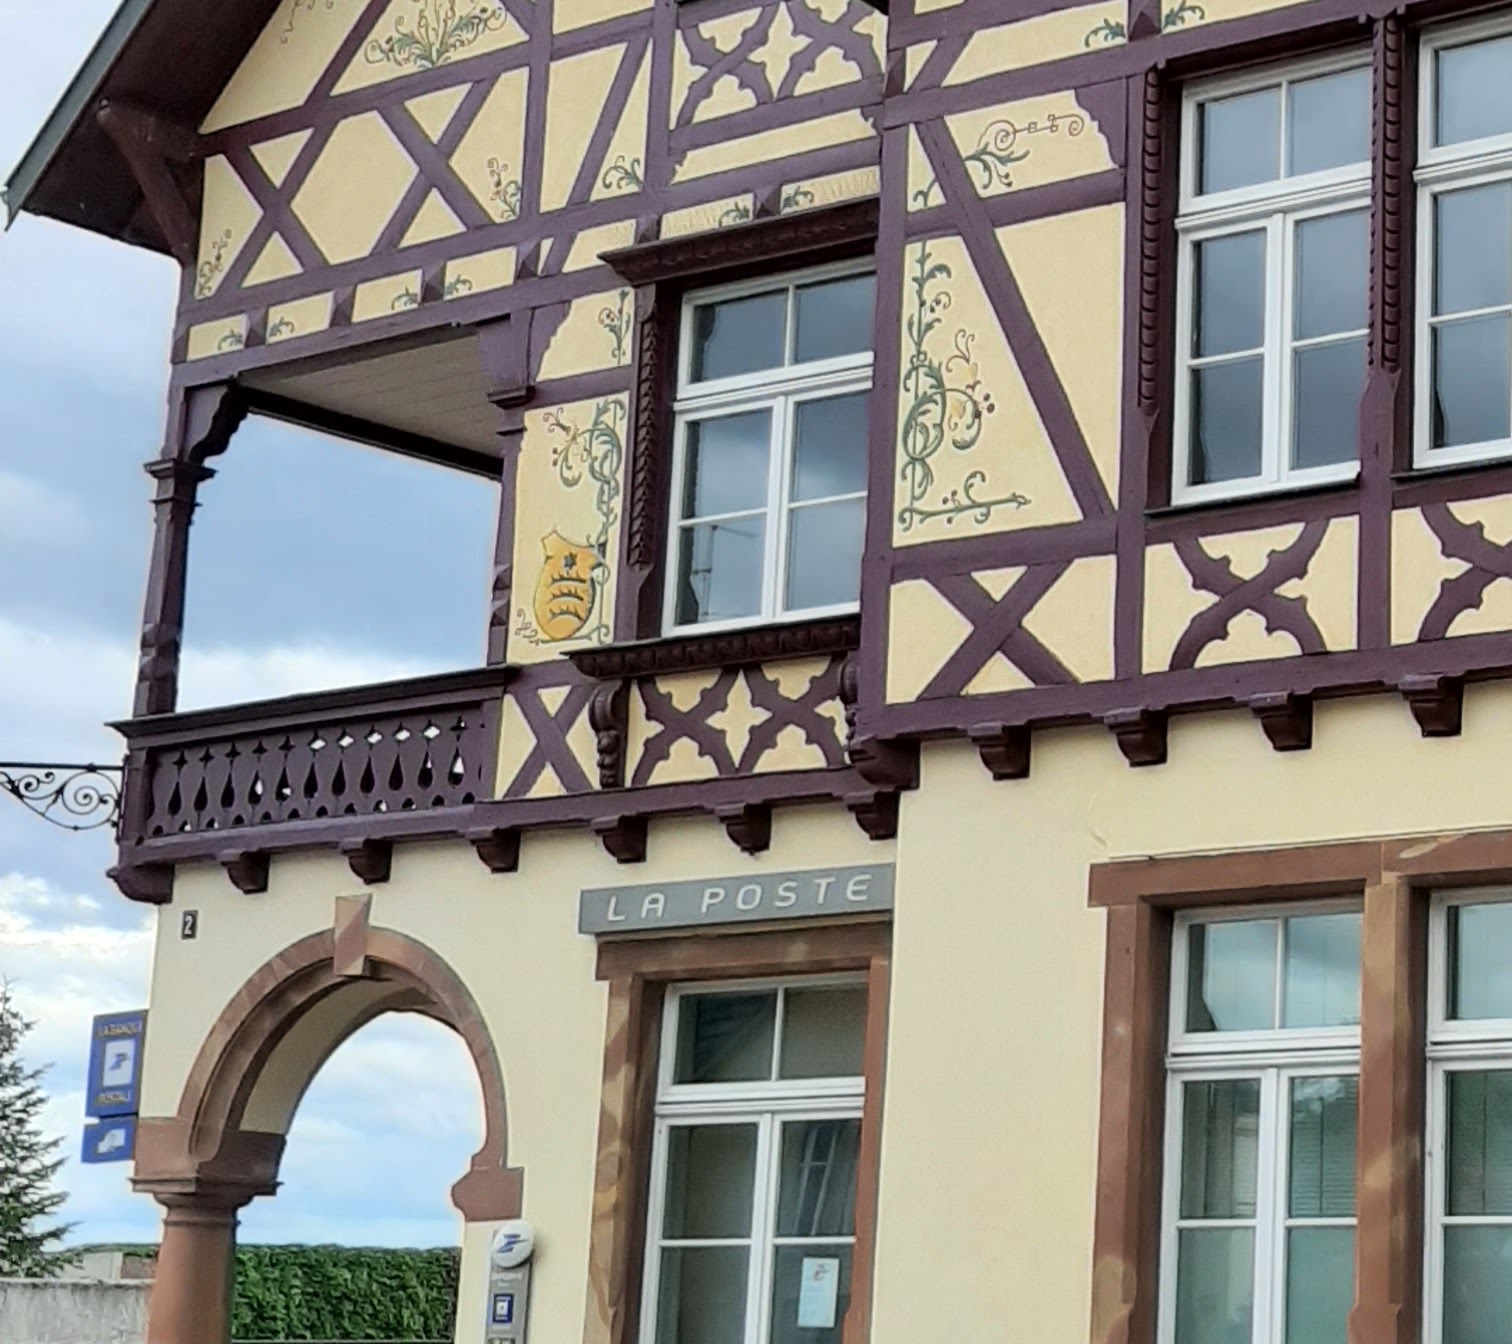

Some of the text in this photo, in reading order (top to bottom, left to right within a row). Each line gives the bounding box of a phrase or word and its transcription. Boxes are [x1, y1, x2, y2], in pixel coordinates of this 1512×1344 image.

[607, 874, 873, 921] LA POSTE
[184, 915, 193, 935] 2
